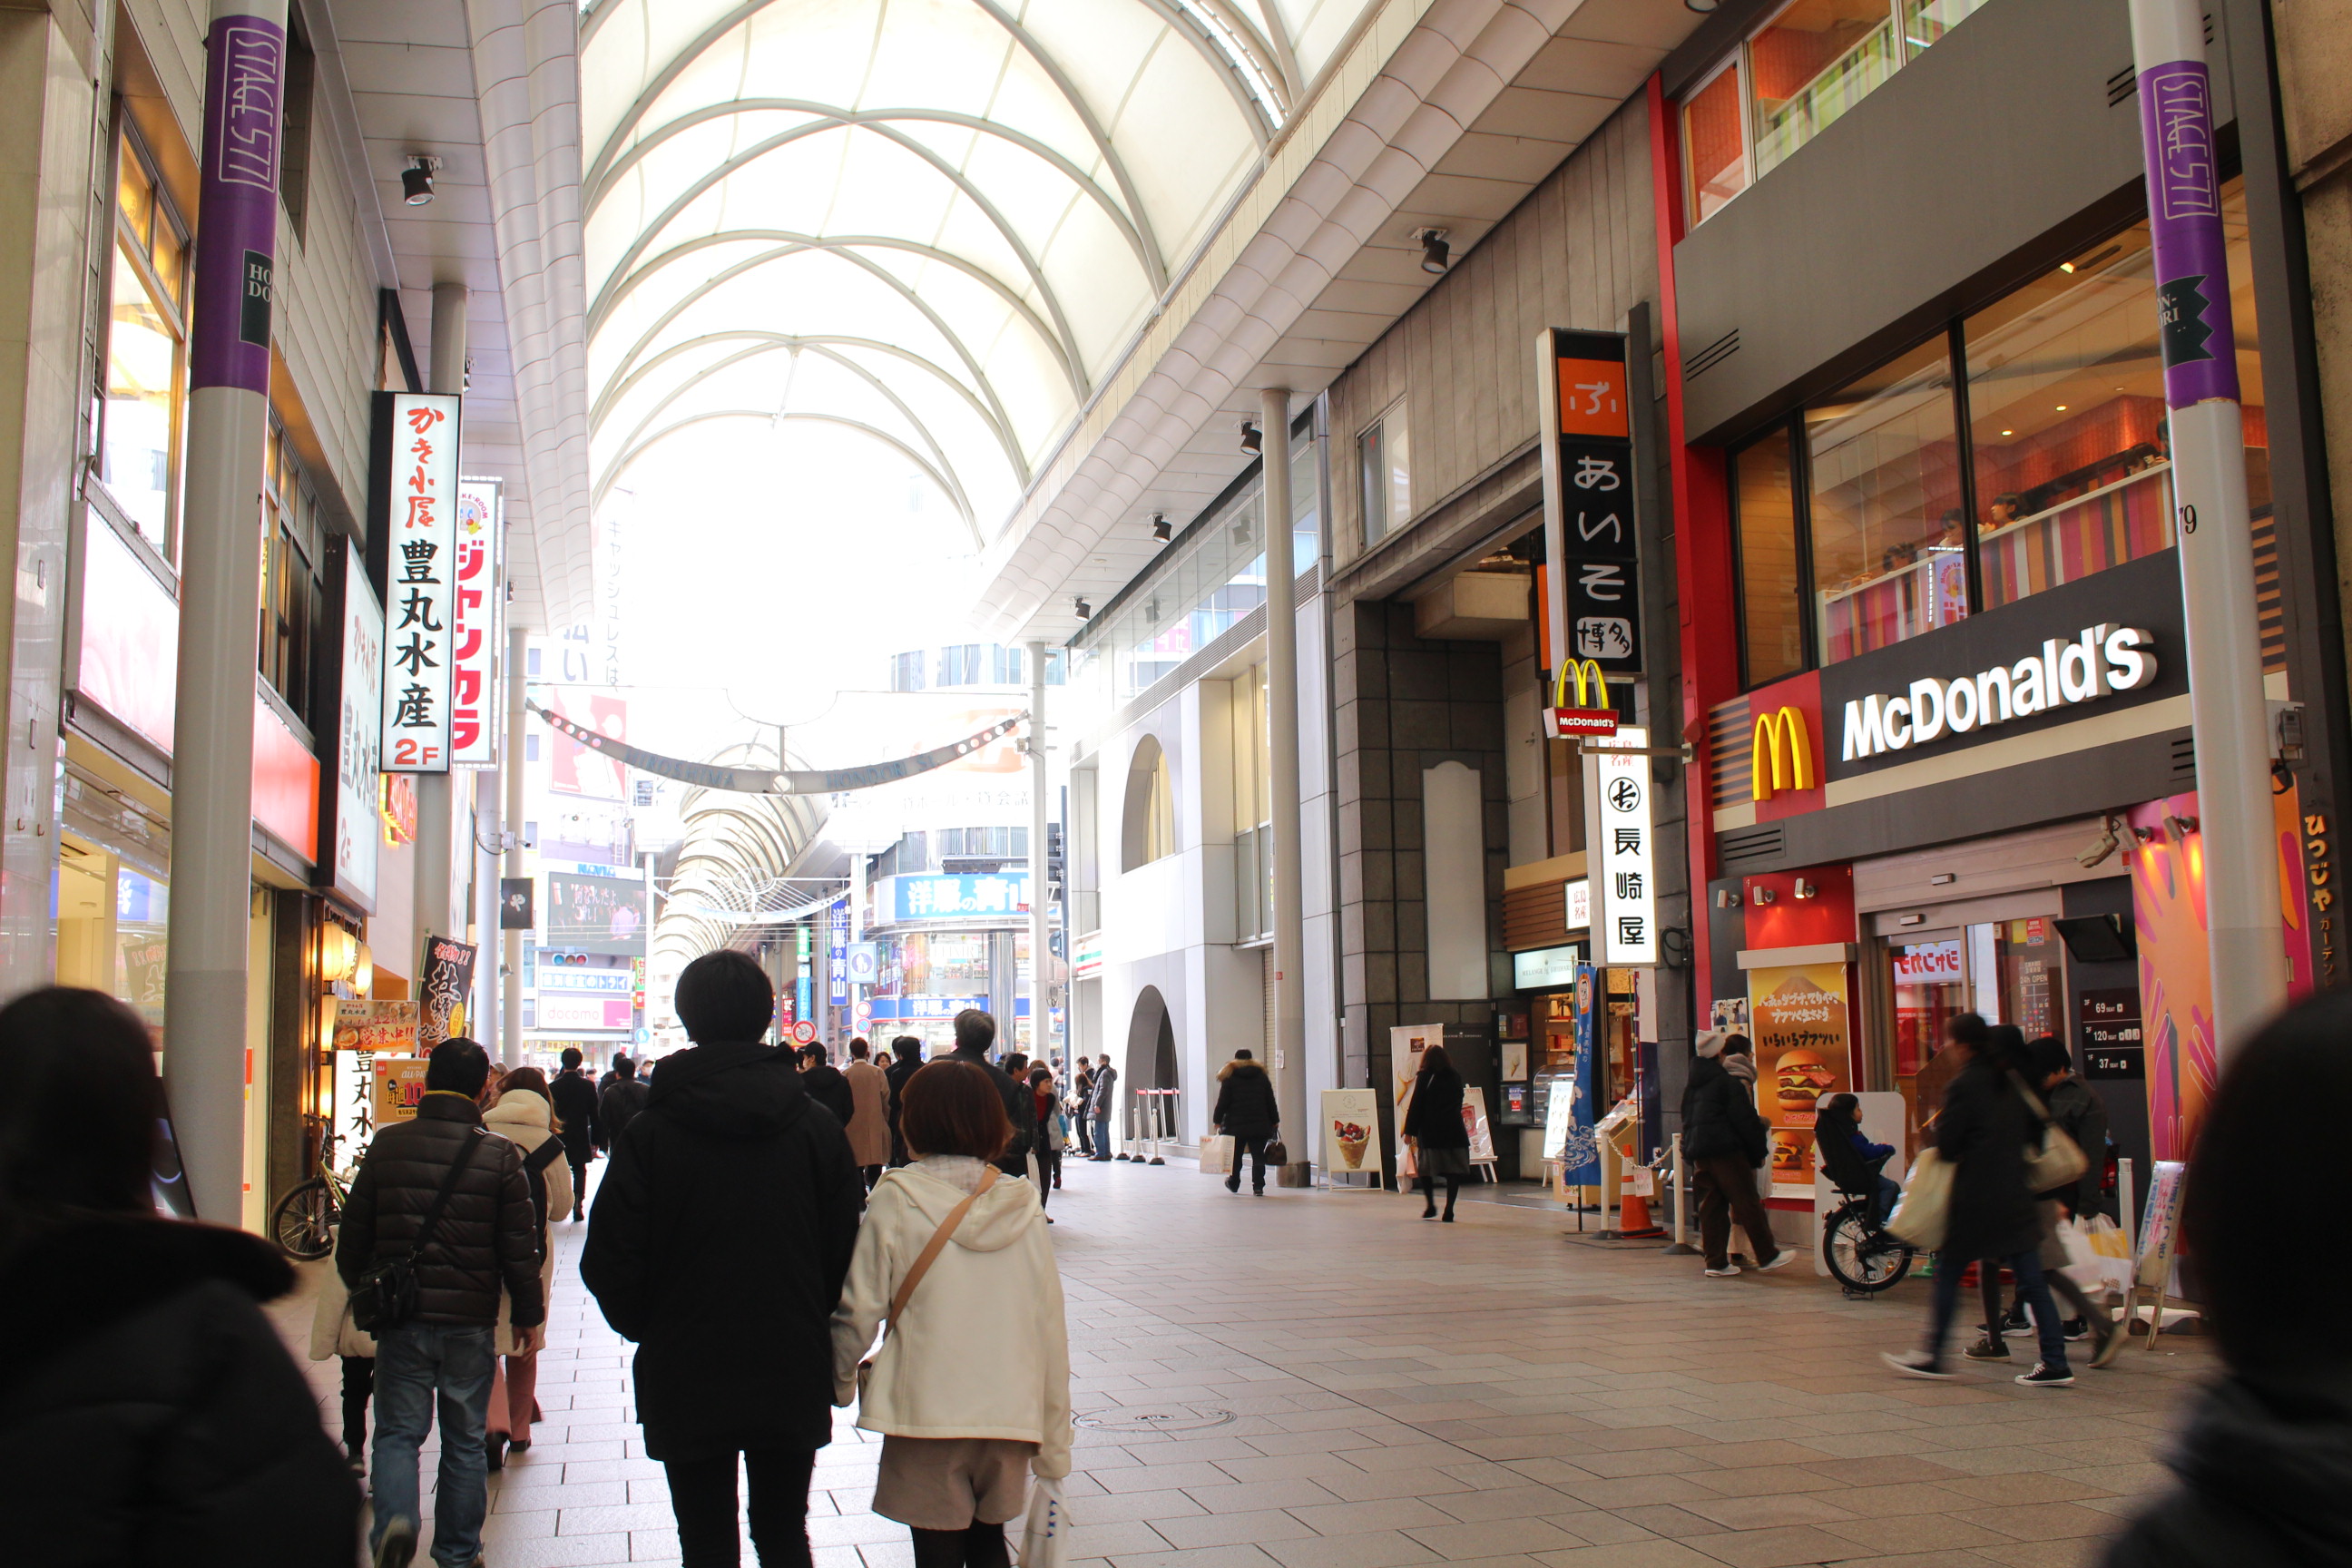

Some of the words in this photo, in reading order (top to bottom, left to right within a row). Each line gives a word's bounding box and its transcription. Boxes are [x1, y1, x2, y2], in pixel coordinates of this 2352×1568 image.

[406, 407, 445, 528] かき小屋
[392, 539, 443, 728] 豊丸水産
[1842, 624, 2154, 762] McDonald's
[1559, 717, 1615, 729] McDonald's
[395, 739, 438, 765] 2F
[826, 760, 907, 789] HONDORI
[2304, 814, 2334, 912] ひつじや
[1613, 828, 1645, 945] 長崎屋
[831, 907, 847, 997] 洋服の青山
[548, 1004, 599, 1020] docomo
[2095, 1003, 2106, 1014] 69
[362, 1026, 414, 1045] 営業中!!
[2093, 1031, 2107, 1041] 120
[2099, 1058, 2109, 1069] 37
